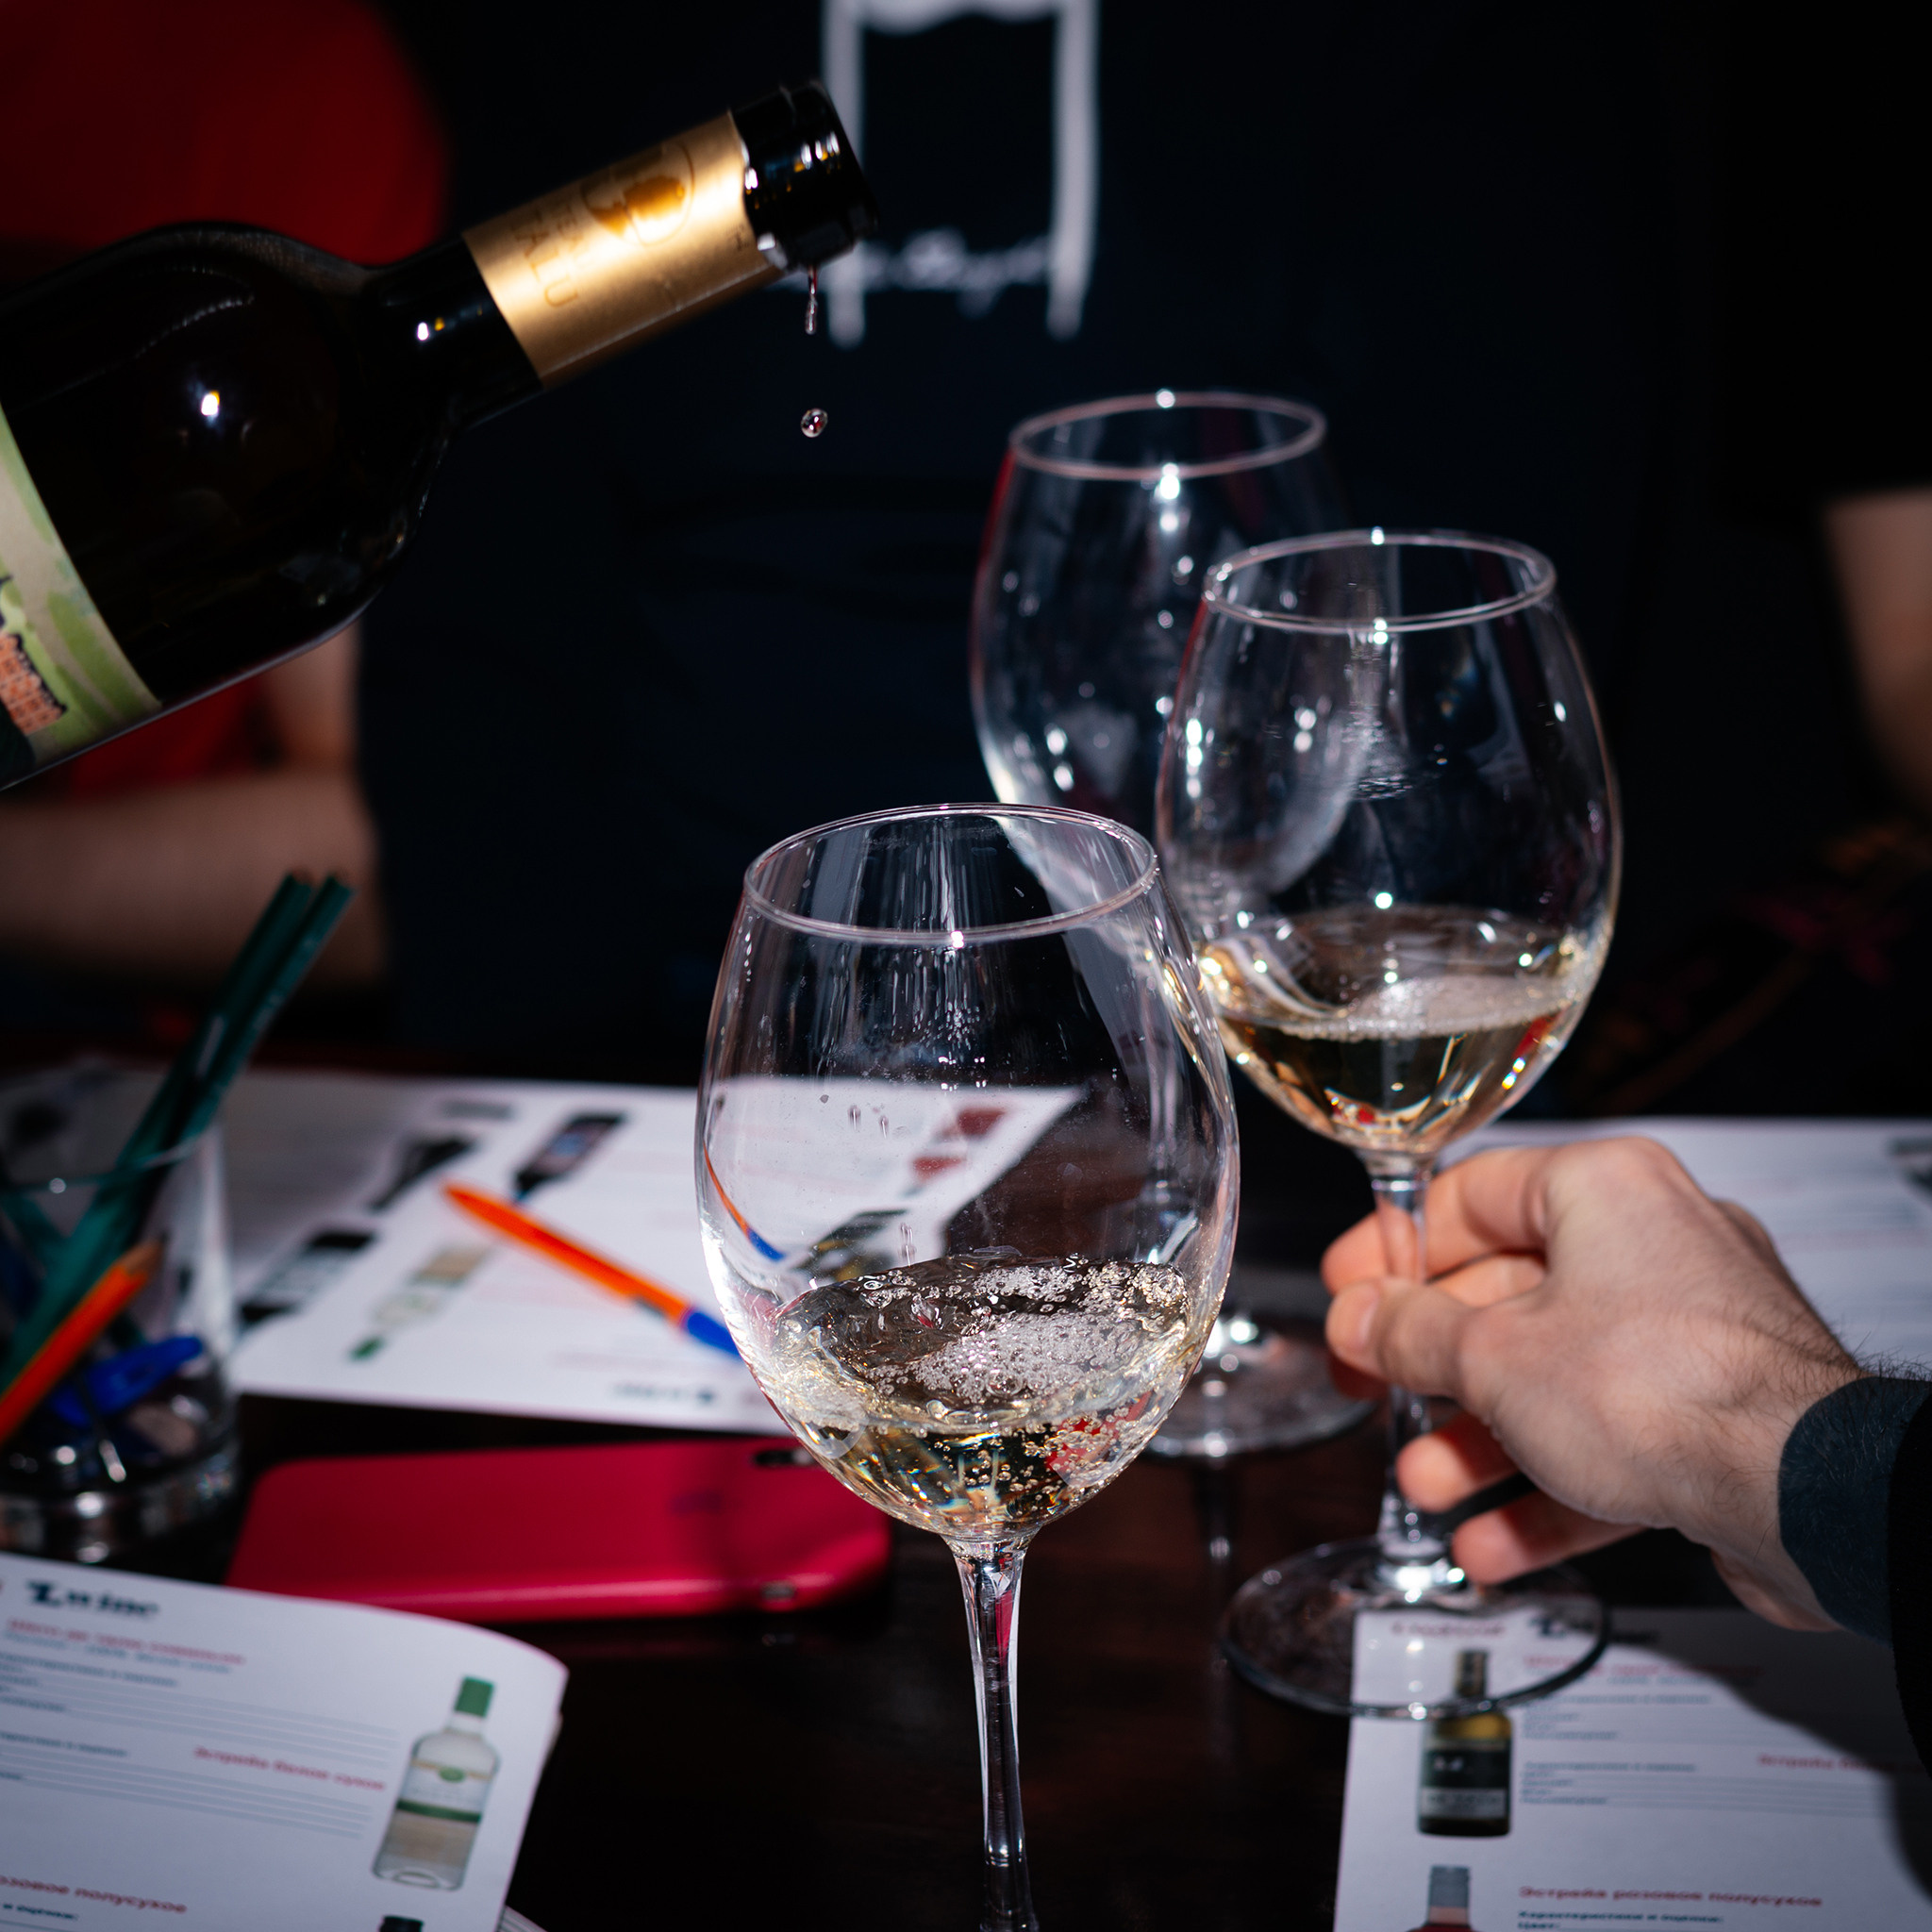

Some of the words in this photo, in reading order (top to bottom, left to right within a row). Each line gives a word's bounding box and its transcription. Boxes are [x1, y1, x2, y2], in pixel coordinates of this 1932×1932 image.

[0, 1874, 70, 1896] озовое
[75, 1888, 188, 1916] полусухое
[1613, 1889, 1703, 1902] розовое
[1708, 1890, 1823, 1907] полусухое
